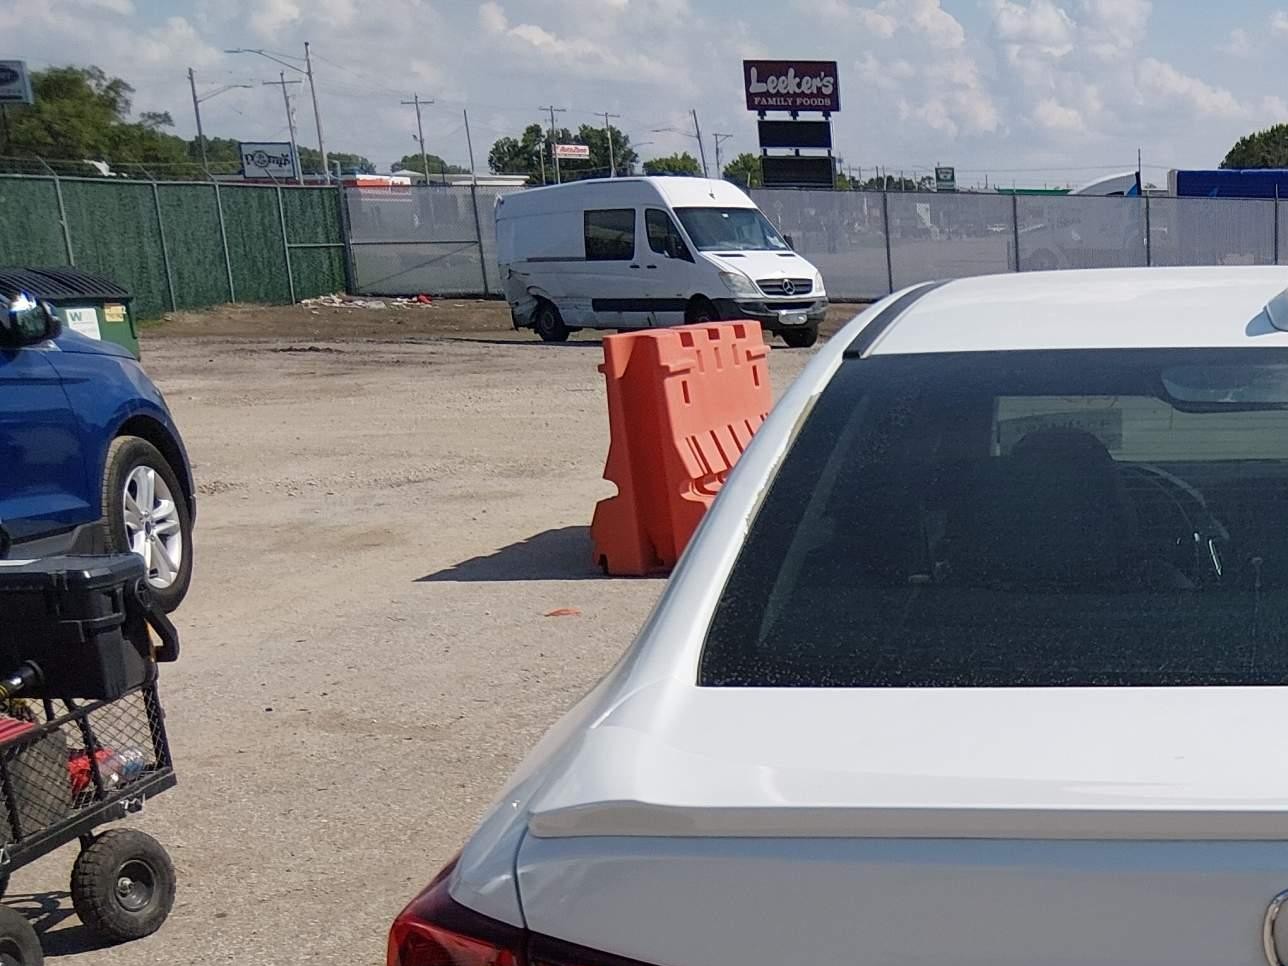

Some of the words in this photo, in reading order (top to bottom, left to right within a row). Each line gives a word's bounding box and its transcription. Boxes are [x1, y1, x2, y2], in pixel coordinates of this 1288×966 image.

[749, 67, 834, 94] Leeker's
[754, 97, 793, 106] FAMILY
[797, 97, 831, 106] FOODS
